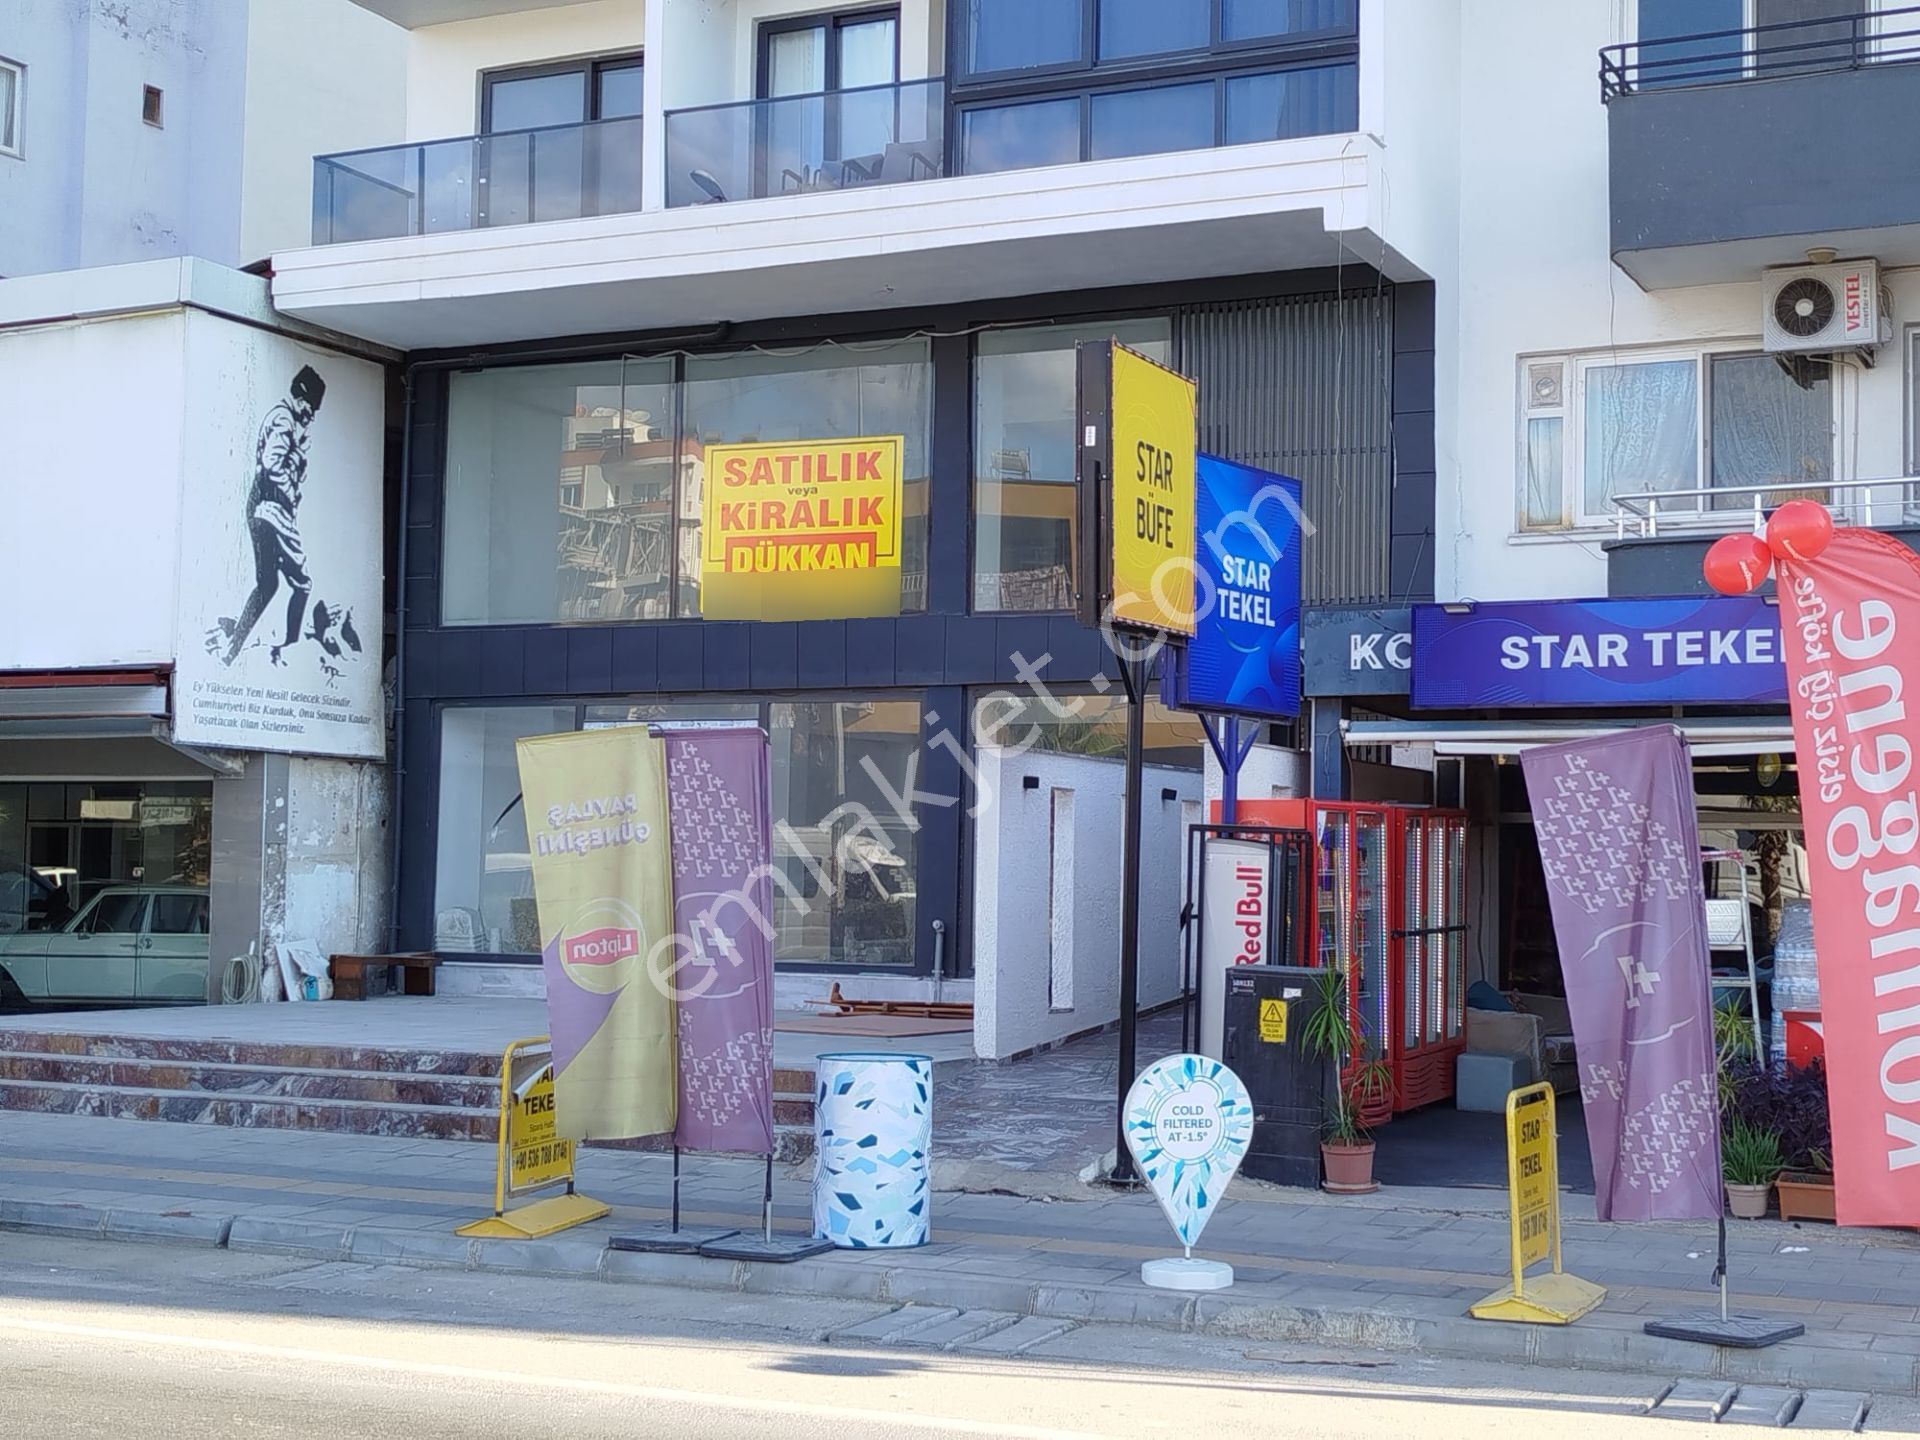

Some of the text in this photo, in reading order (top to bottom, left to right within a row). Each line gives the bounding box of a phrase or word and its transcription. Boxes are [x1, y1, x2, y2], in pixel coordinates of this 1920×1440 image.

[1846, 273, 1860, 332] VESTEL
[723, 451, 883, 487] SATILIK
[1136, 440, 1174, 493] STAR
[787, 486, 818, 497] veya
[1136, 491, 1174, 549] BÜFE
[731, 539, 870, 572] DÜKKAN
[1222, 554, 1271, 592] STAR
[1217, 588, 1276, 627] TEKEL
[1500, 629, 1786, 670] STAR TEKE
[205, 682, 244, 696] Yükselen
[246, 687, 264, 698] Yeni
[290, 692, 321, 704] Gelecek
[192, 698, 247, 713] Cumhuriyeti
[248, 703, 261, 714] Biz
[262, 705, 296, 719] Kurduk,
[298, 708, 315, 719] Onu
[316, 710, 347, 722] Sonsuza
[193, 714, 238, 729] Yaşatacak
[240, 719, 259, 730] Olan
[1236, 867, 1263, 917] Bull
[524, 1093, 555, 1116] TEKE
[1172, 1106, 1204, 1116] COLD
[1163, 1119, 1213, 1129] FILTERED
[1521, 1119, 1541, 1144] STAR
[1519, 1152, 1542, 1179] TEKEL
